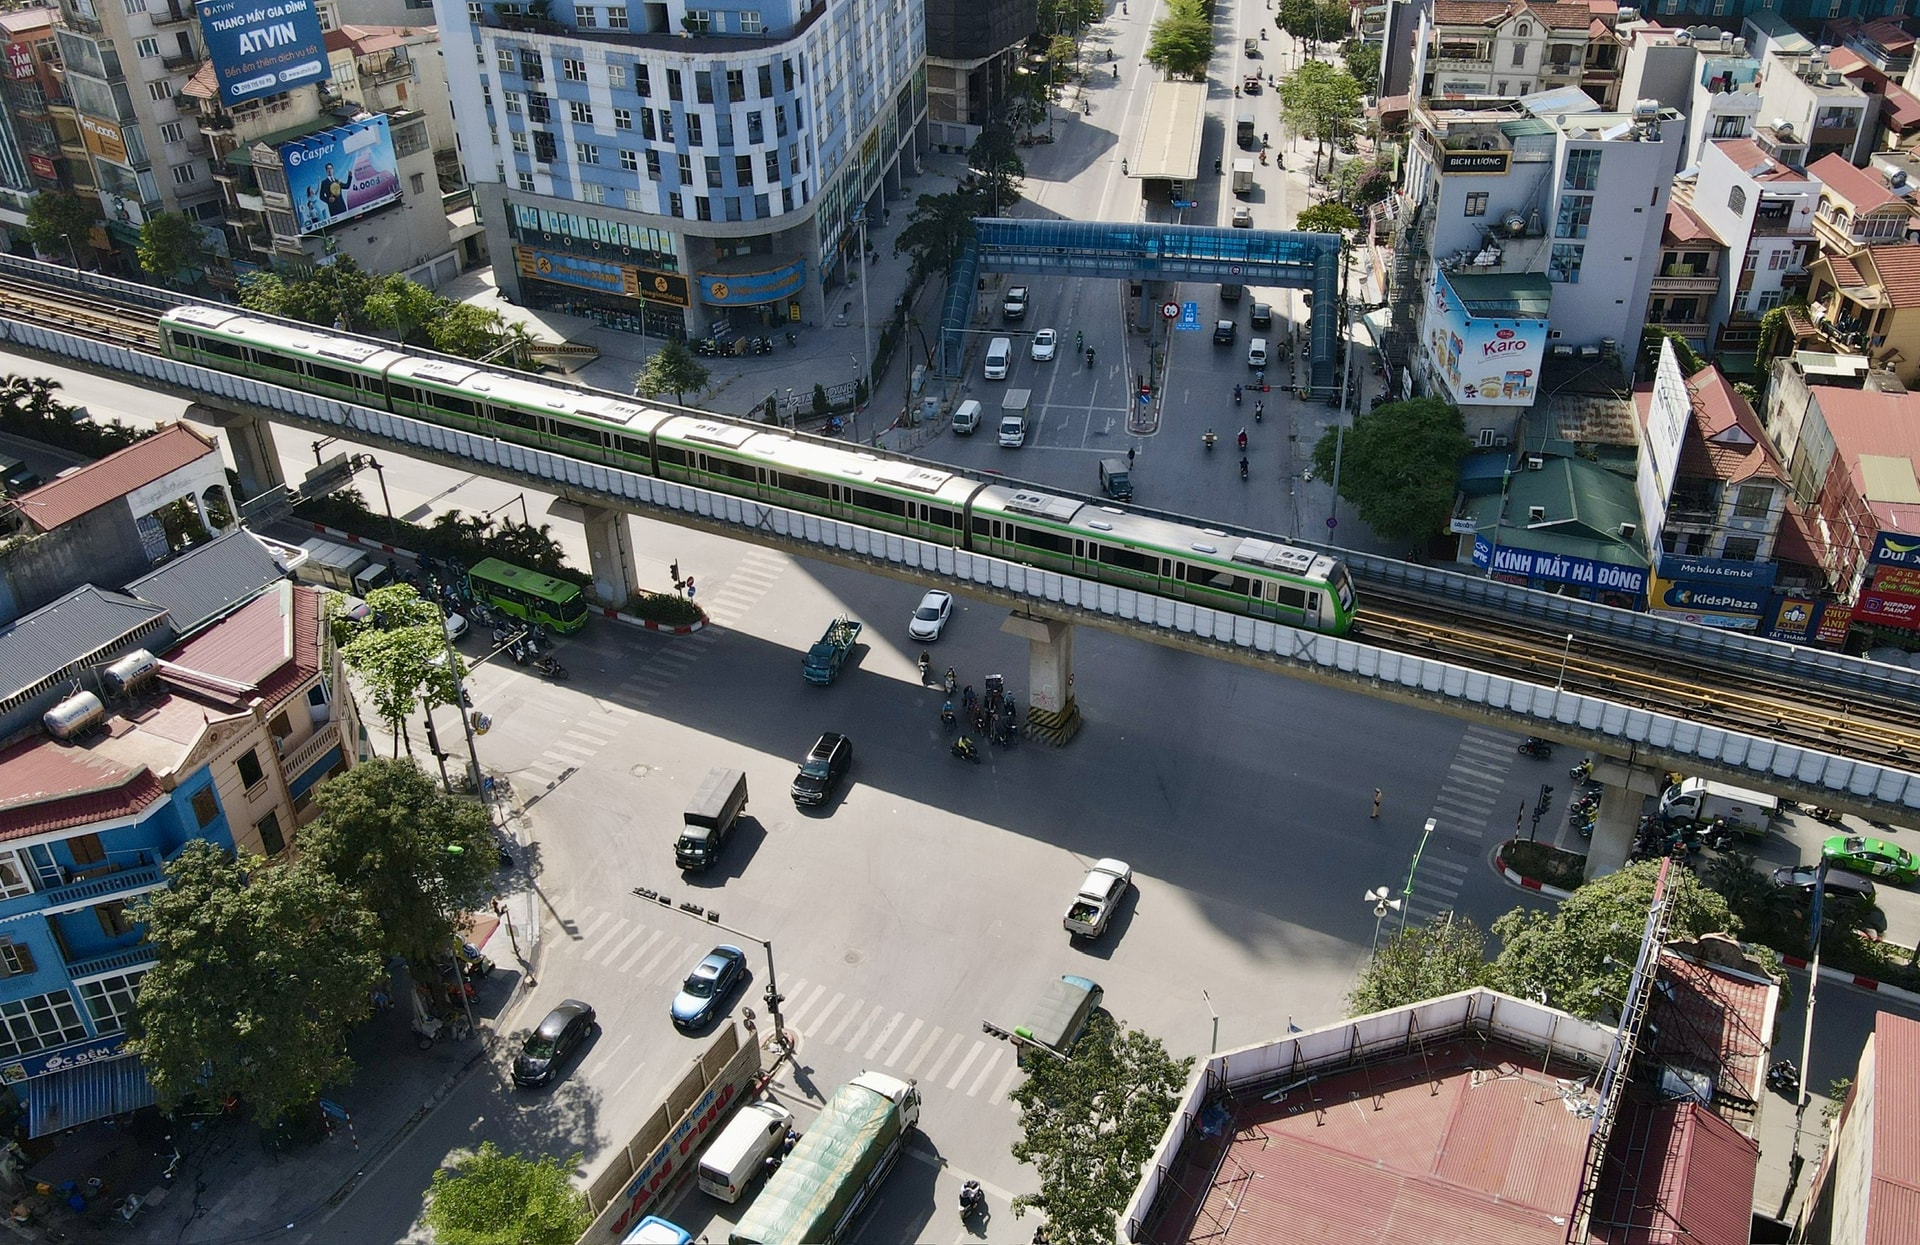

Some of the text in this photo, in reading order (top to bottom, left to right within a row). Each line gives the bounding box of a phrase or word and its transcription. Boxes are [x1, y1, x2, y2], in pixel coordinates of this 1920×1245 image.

[212, 3, 234, 14] ATVIN
[212, 1, 307, 31] THANG MÁY GIA ĐÌNH
[240, 21, 297, 55] ATVIN
[10, 52, 31, 66] TÂM
[15, 64, 35, 79] ANH
[301, 143, 335, 162] Casper
[1450, 156, 1501, 166] BÍCH LƯƠNG
[1484, 340, 1526, 356] Karo
[1879, 547, 1920, 564] Dulx
[1494, 549, 1642, 590] KÍNH MẮT HÀ ĐÔNG
[1680, 564, 1696, 574] Mẹ
[1696, 564, 1715, 574] bầu
[1724, 568, 1739, 577] Em
[1740, 569, 1753, 578] bé
[1693, 594, 1758, 610] KidsPlaza
[1882, 601, 1917, 610] NIPPON
[1824, 609, 1852, 620] CHỤP
[1883, 606, 1909, 615] PAINT
[1777, 621, 1805, 630] JOTUN
[45, 1052, 73, 1069] ỐC
[76, 1047, 110, 1061] ĐÊM
[609, 1082, 734, 1235] VĂN PHÚ
